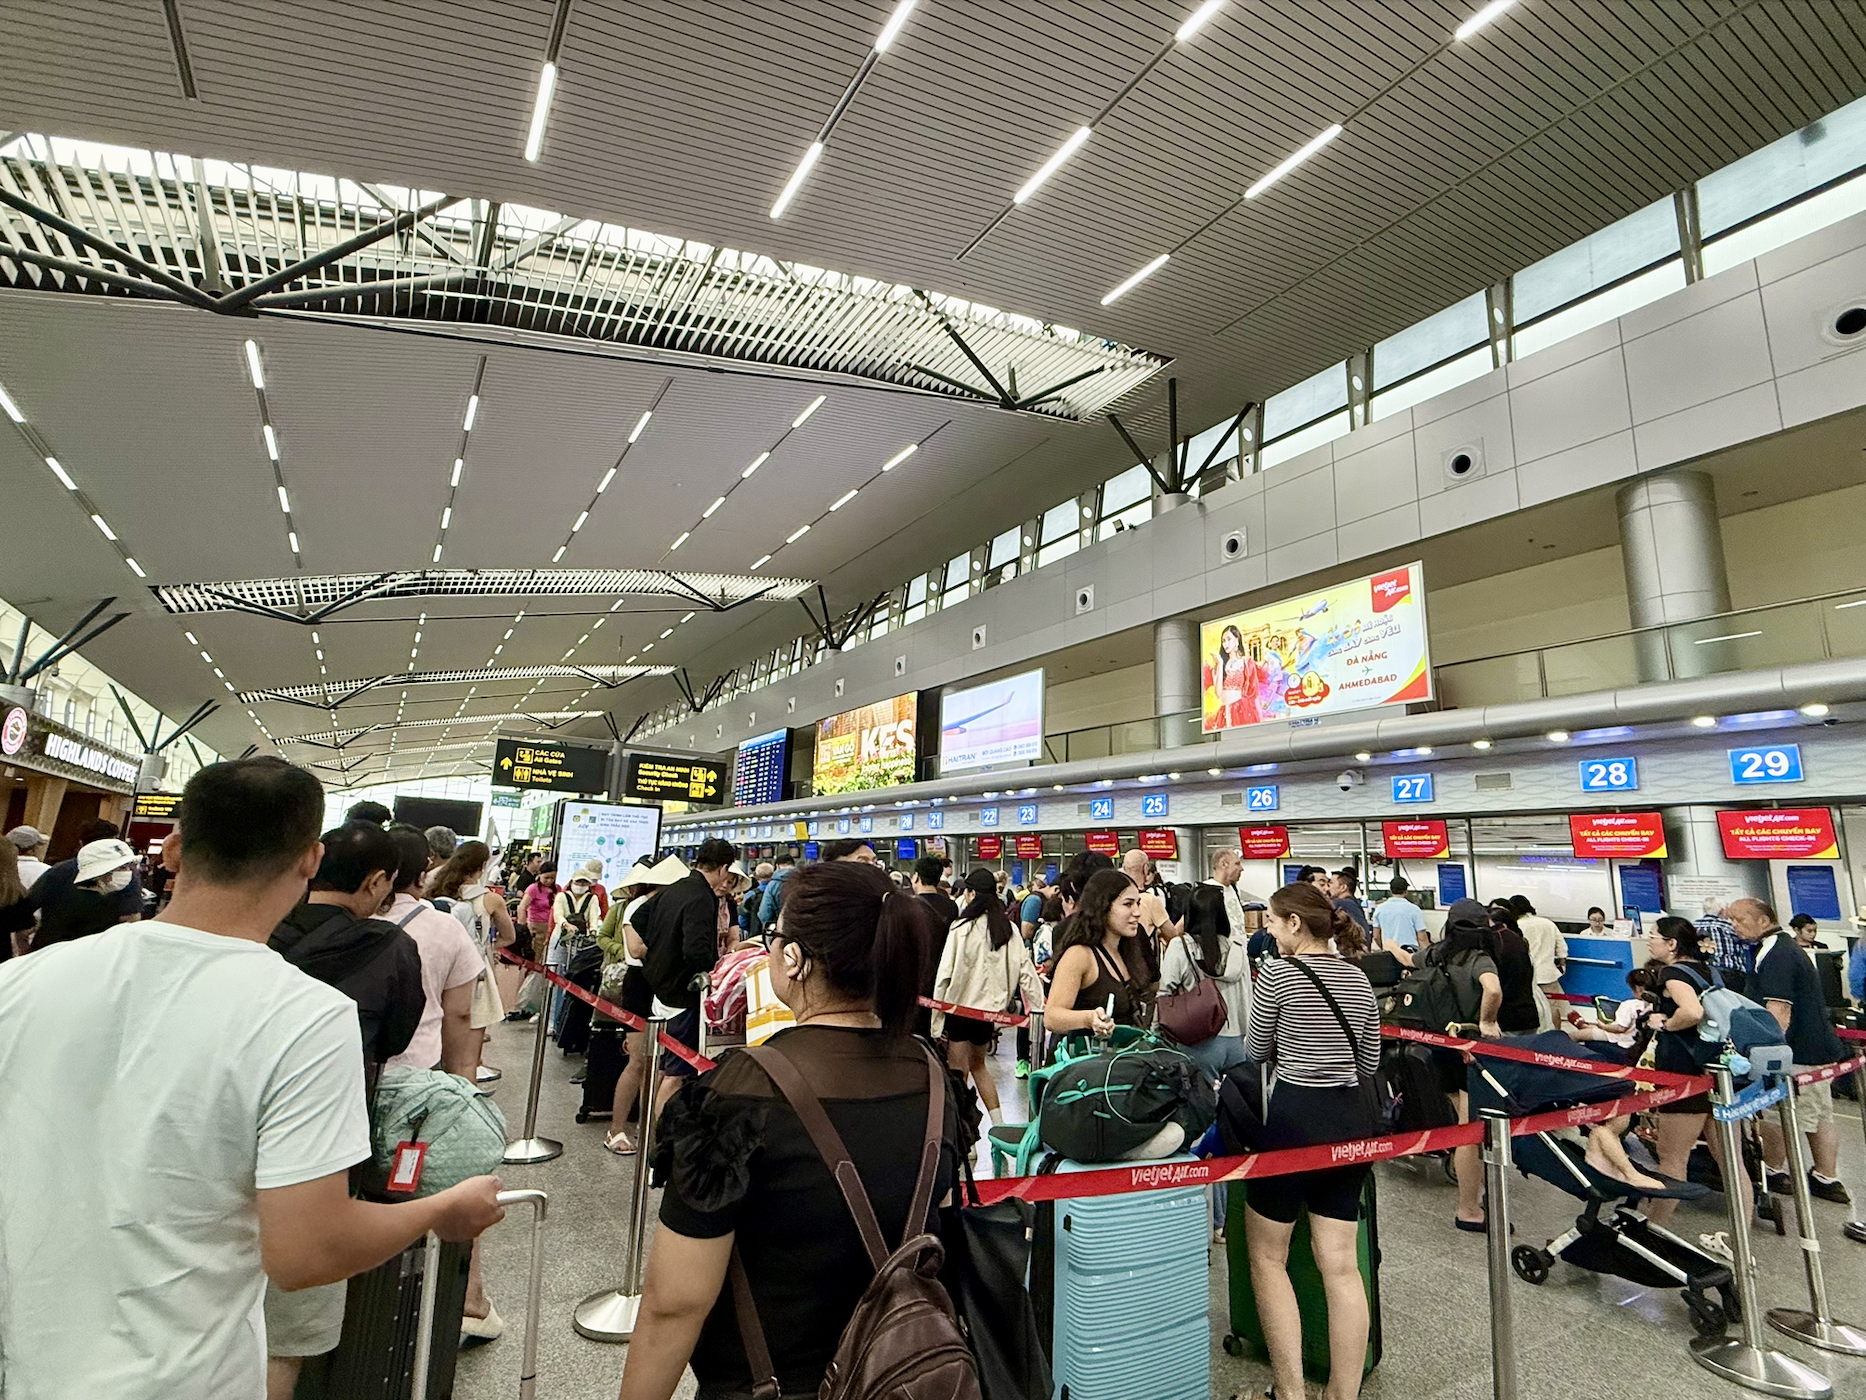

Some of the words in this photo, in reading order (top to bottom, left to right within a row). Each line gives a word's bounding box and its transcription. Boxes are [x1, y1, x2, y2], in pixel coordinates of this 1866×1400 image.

[1339, 674, 1397, 690] AHMEDABAD
[862, 719, 914, 765] KES
[45, 733, 108, 774] HIGHLANDS
[107, 757, 138, 784] COFFEE
[1740, 751, 1789, 778] 29
[1588, 763, 1628, 787] 28
[1398, 778, 1425, 798] 27
[1146, 798, 1163, 813] 25
[1251, 789, 1273, 807] 26
[983, 811, 995, 823] 22
[1022, 808, 1033, 821] 23
[1094, 802, 1109, 816] 24
[902, 817, 911, 827] 20
[930, 815, 940, 826] 21
